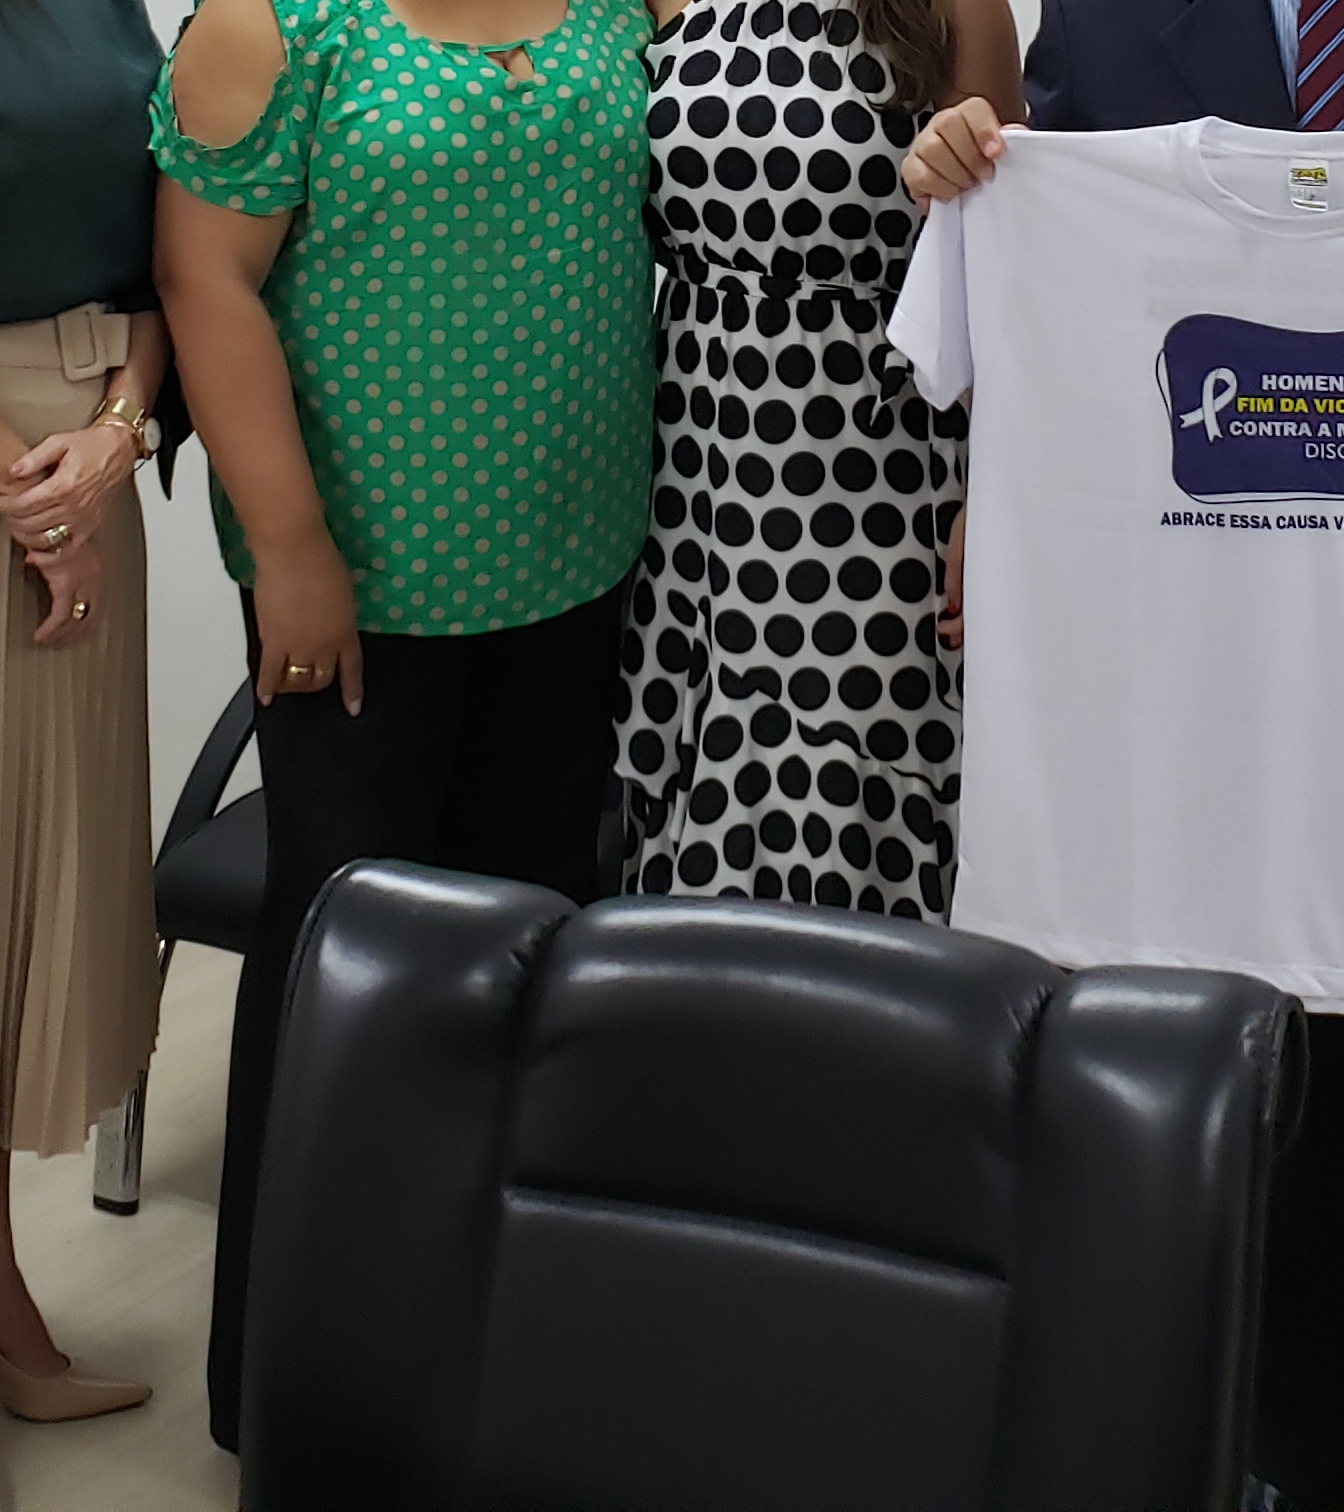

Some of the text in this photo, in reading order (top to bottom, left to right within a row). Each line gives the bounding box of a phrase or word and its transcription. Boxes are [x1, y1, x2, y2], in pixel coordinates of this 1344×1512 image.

[1236, 397, 1275, 413] FIM
[1279, 397, 1309, 413] DA
[1229, 421, 1313, 437] CONTRA
[1317, 422, 1332, 437] A
[1160, 511, 1225, 527] ABRACE
[1230, 514, 1272, 530] ESSA
[1276, 515, 1329, 530] CAUSA
